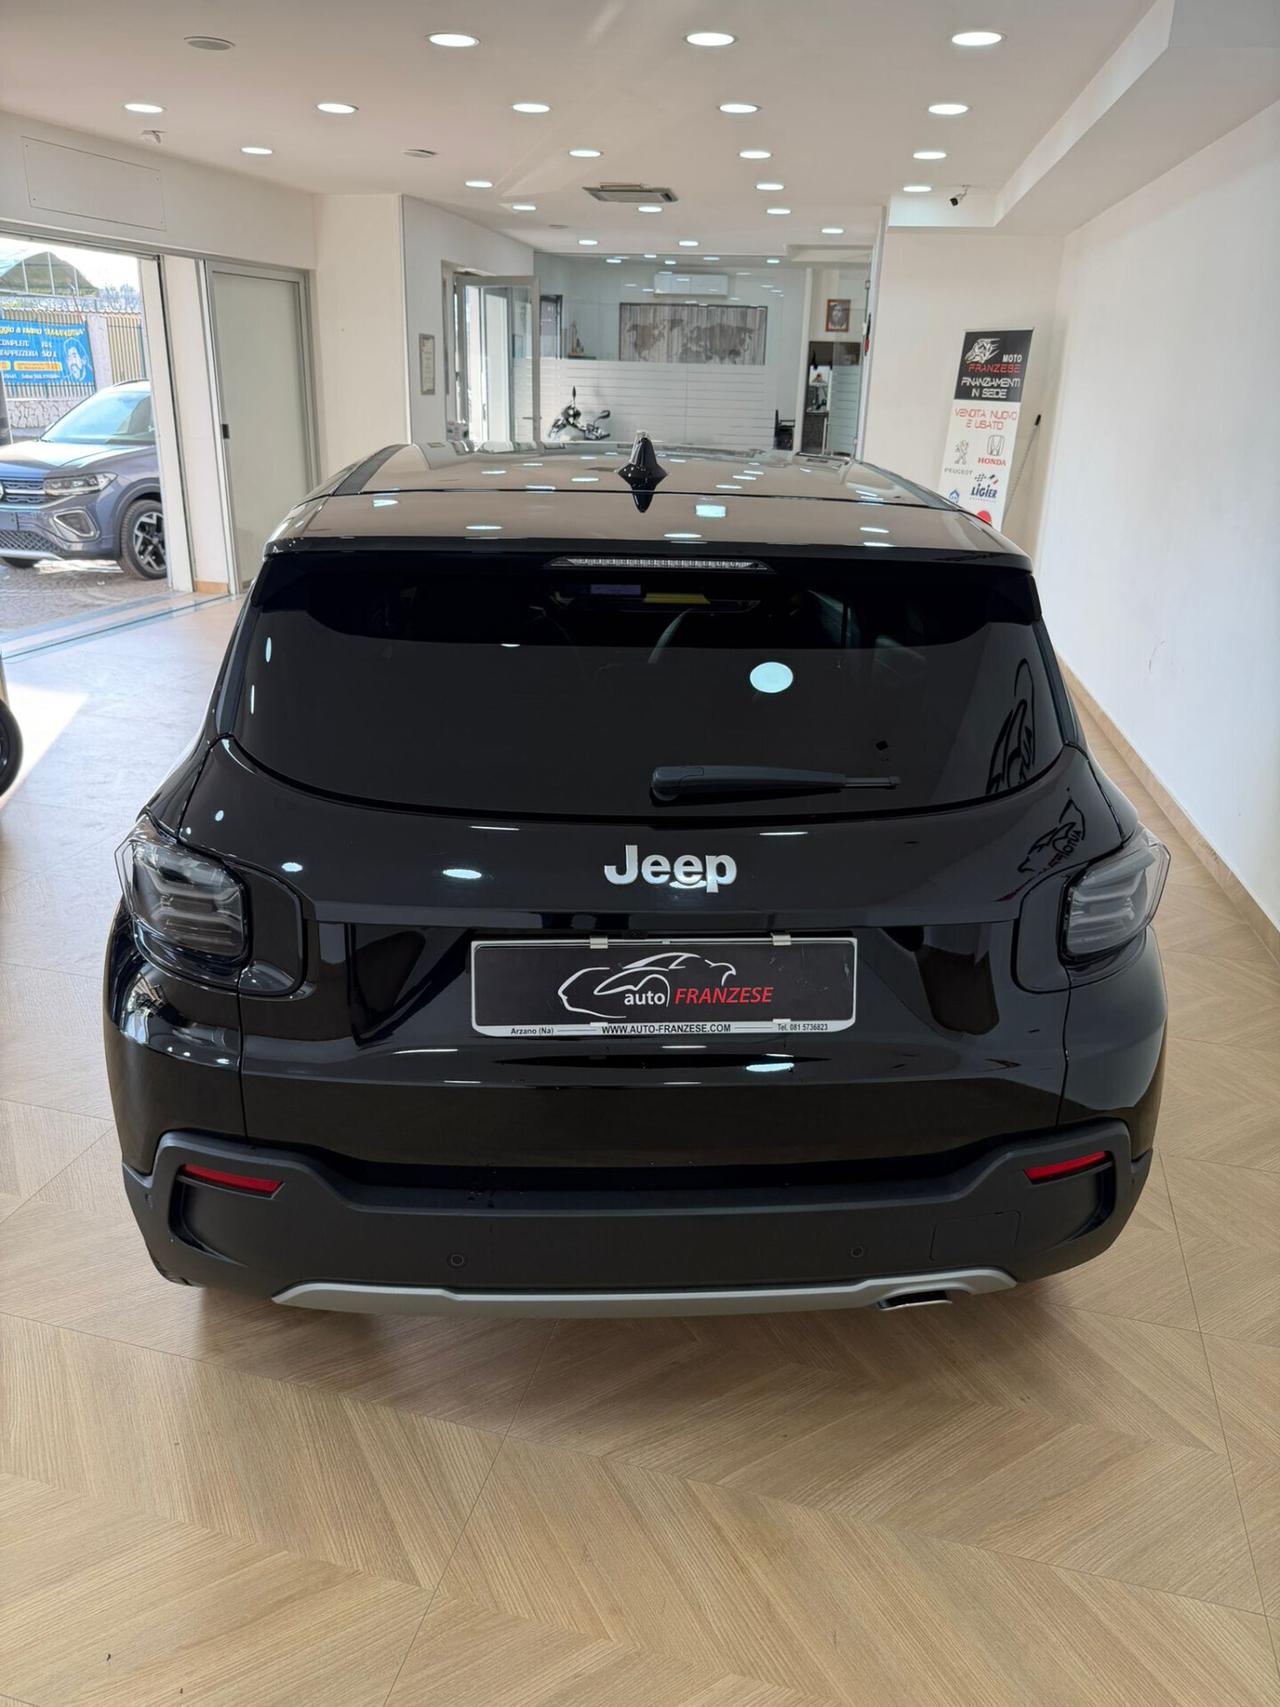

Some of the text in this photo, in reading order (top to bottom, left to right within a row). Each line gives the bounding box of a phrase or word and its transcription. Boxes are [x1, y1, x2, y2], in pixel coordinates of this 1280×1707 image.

[1002, 354, 1023, 363] MOTO
[968, 363, 1021, 373] FRANZESE
[981, 388, 1008, 398] SEDE
[977, 457, 1007, 466] HONDA
[603, 844, 738, 894] Jeep
[624, 987, 774, 1006] auto FRANZESE
[510, 1026, 554, 1035] Arzano (Na)
[602, 1023, 731, 1035] WWW.AUTO-FRANZESE.COM
[777, 1023, 788, 1031] Tel.
[802, 1022, 828, 1031] 5736823
